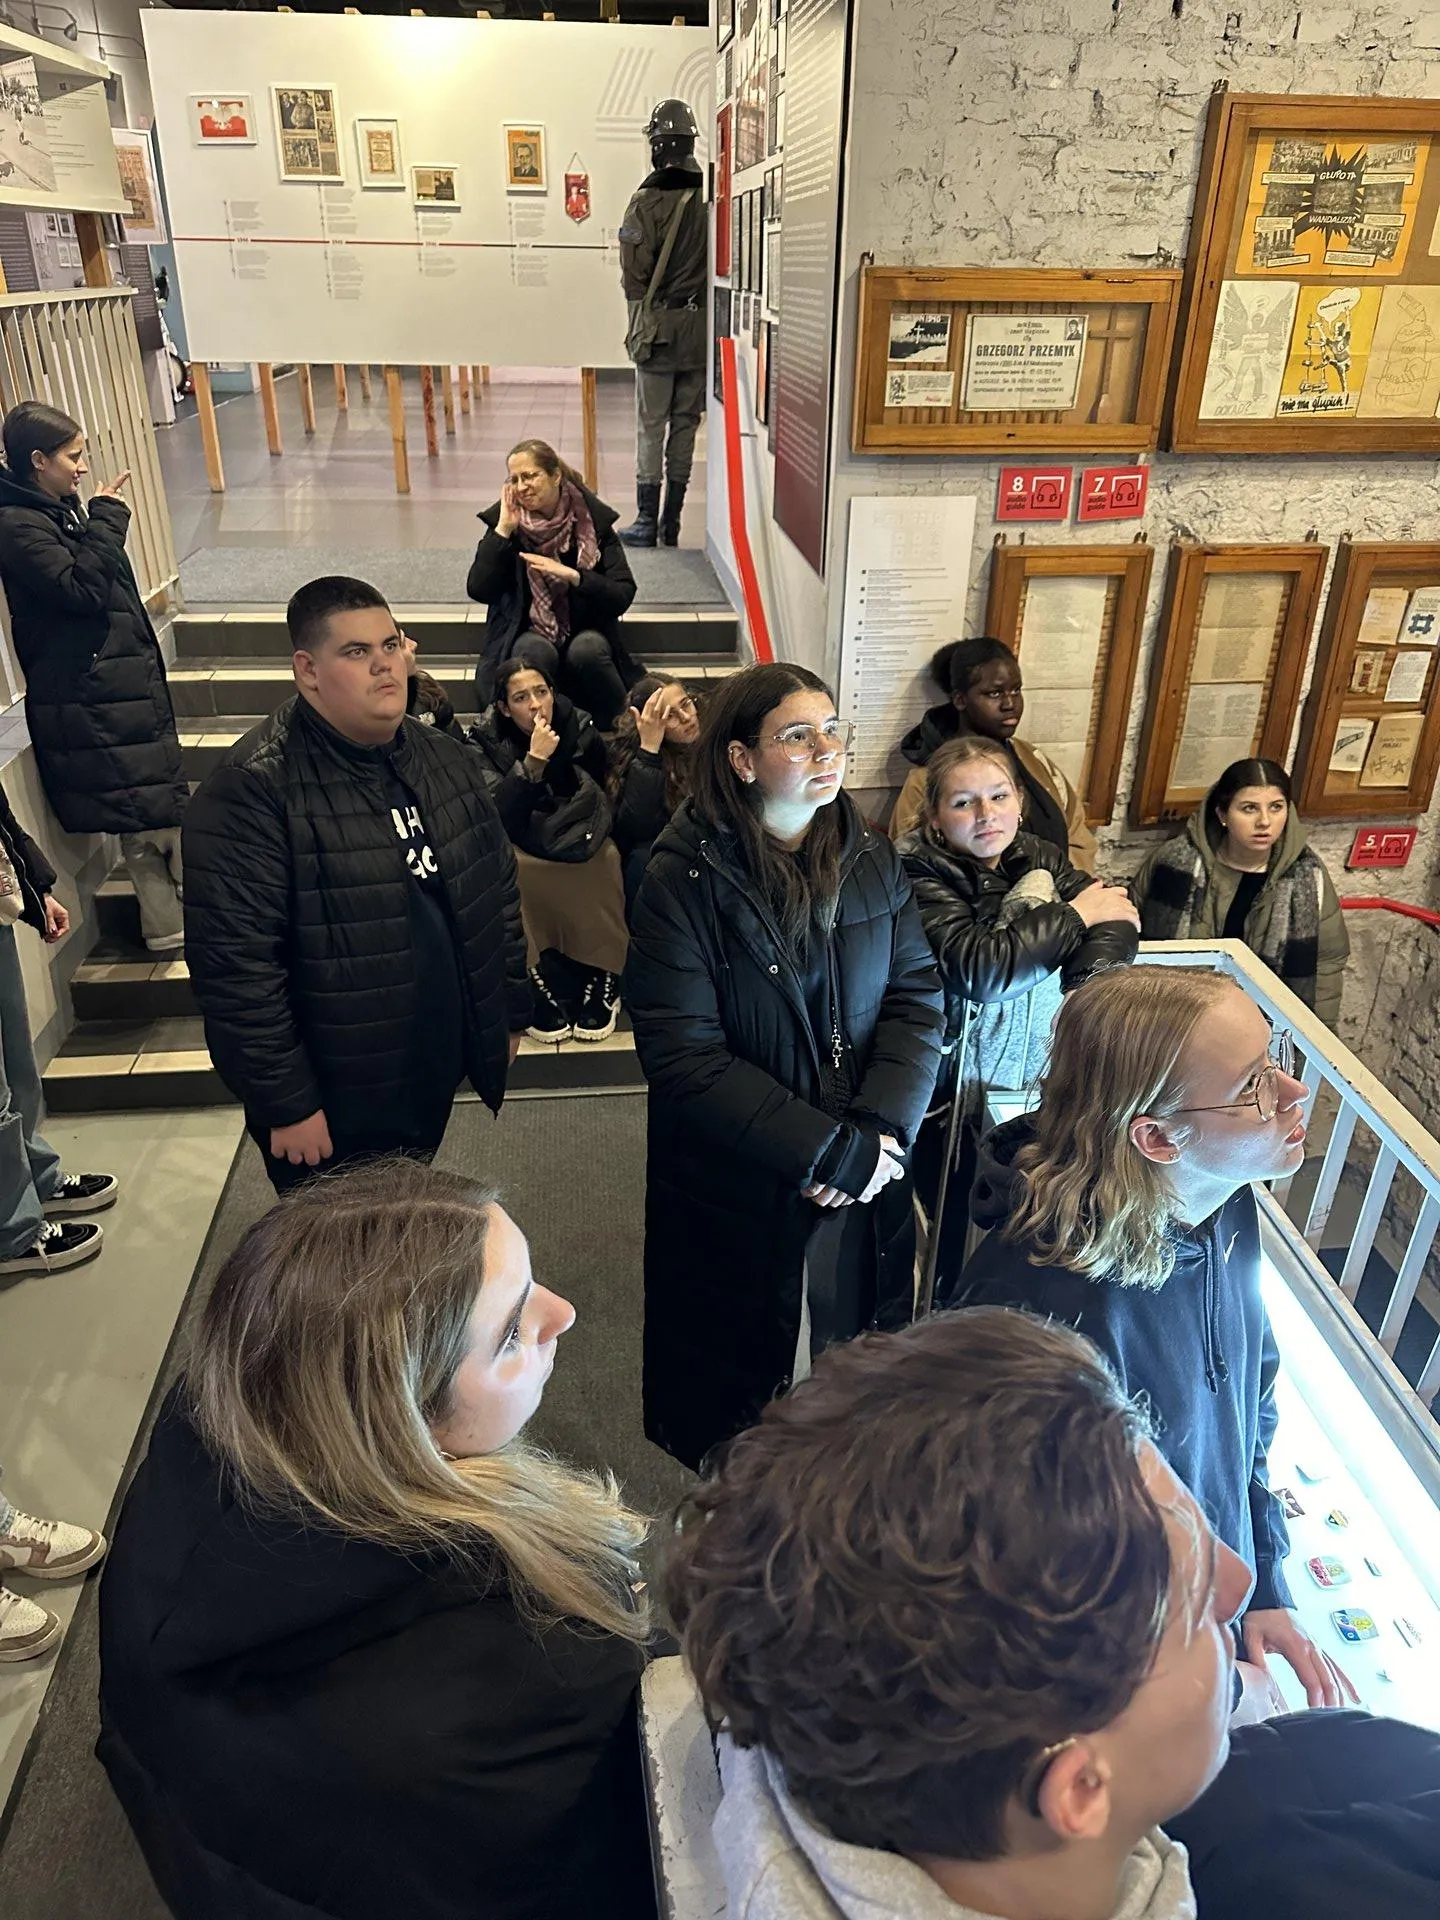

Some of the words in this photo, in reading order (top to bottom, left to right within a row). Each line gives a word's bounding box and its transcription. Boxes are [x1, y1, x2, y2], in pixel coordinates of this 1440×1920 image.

[1309, 215, 1357, 224] WANDALIZM
[976, 344, 1025, 357] GRZEGORZ
[1029, 344, 1076, 357] PRZEMYK
[1281, 398, 1296, 411] nie
[1012, 476, 1024, 492] 8
[1094, 477, 1105, 493] 7
[1006, 494, 1027, 504] audio
[1088, 494, 1107, 504] audio
[1005, 502, 1026, 512] guide
[1087, 502, 1106, 512] guide
[1365, 834, 1377, 847] 5
